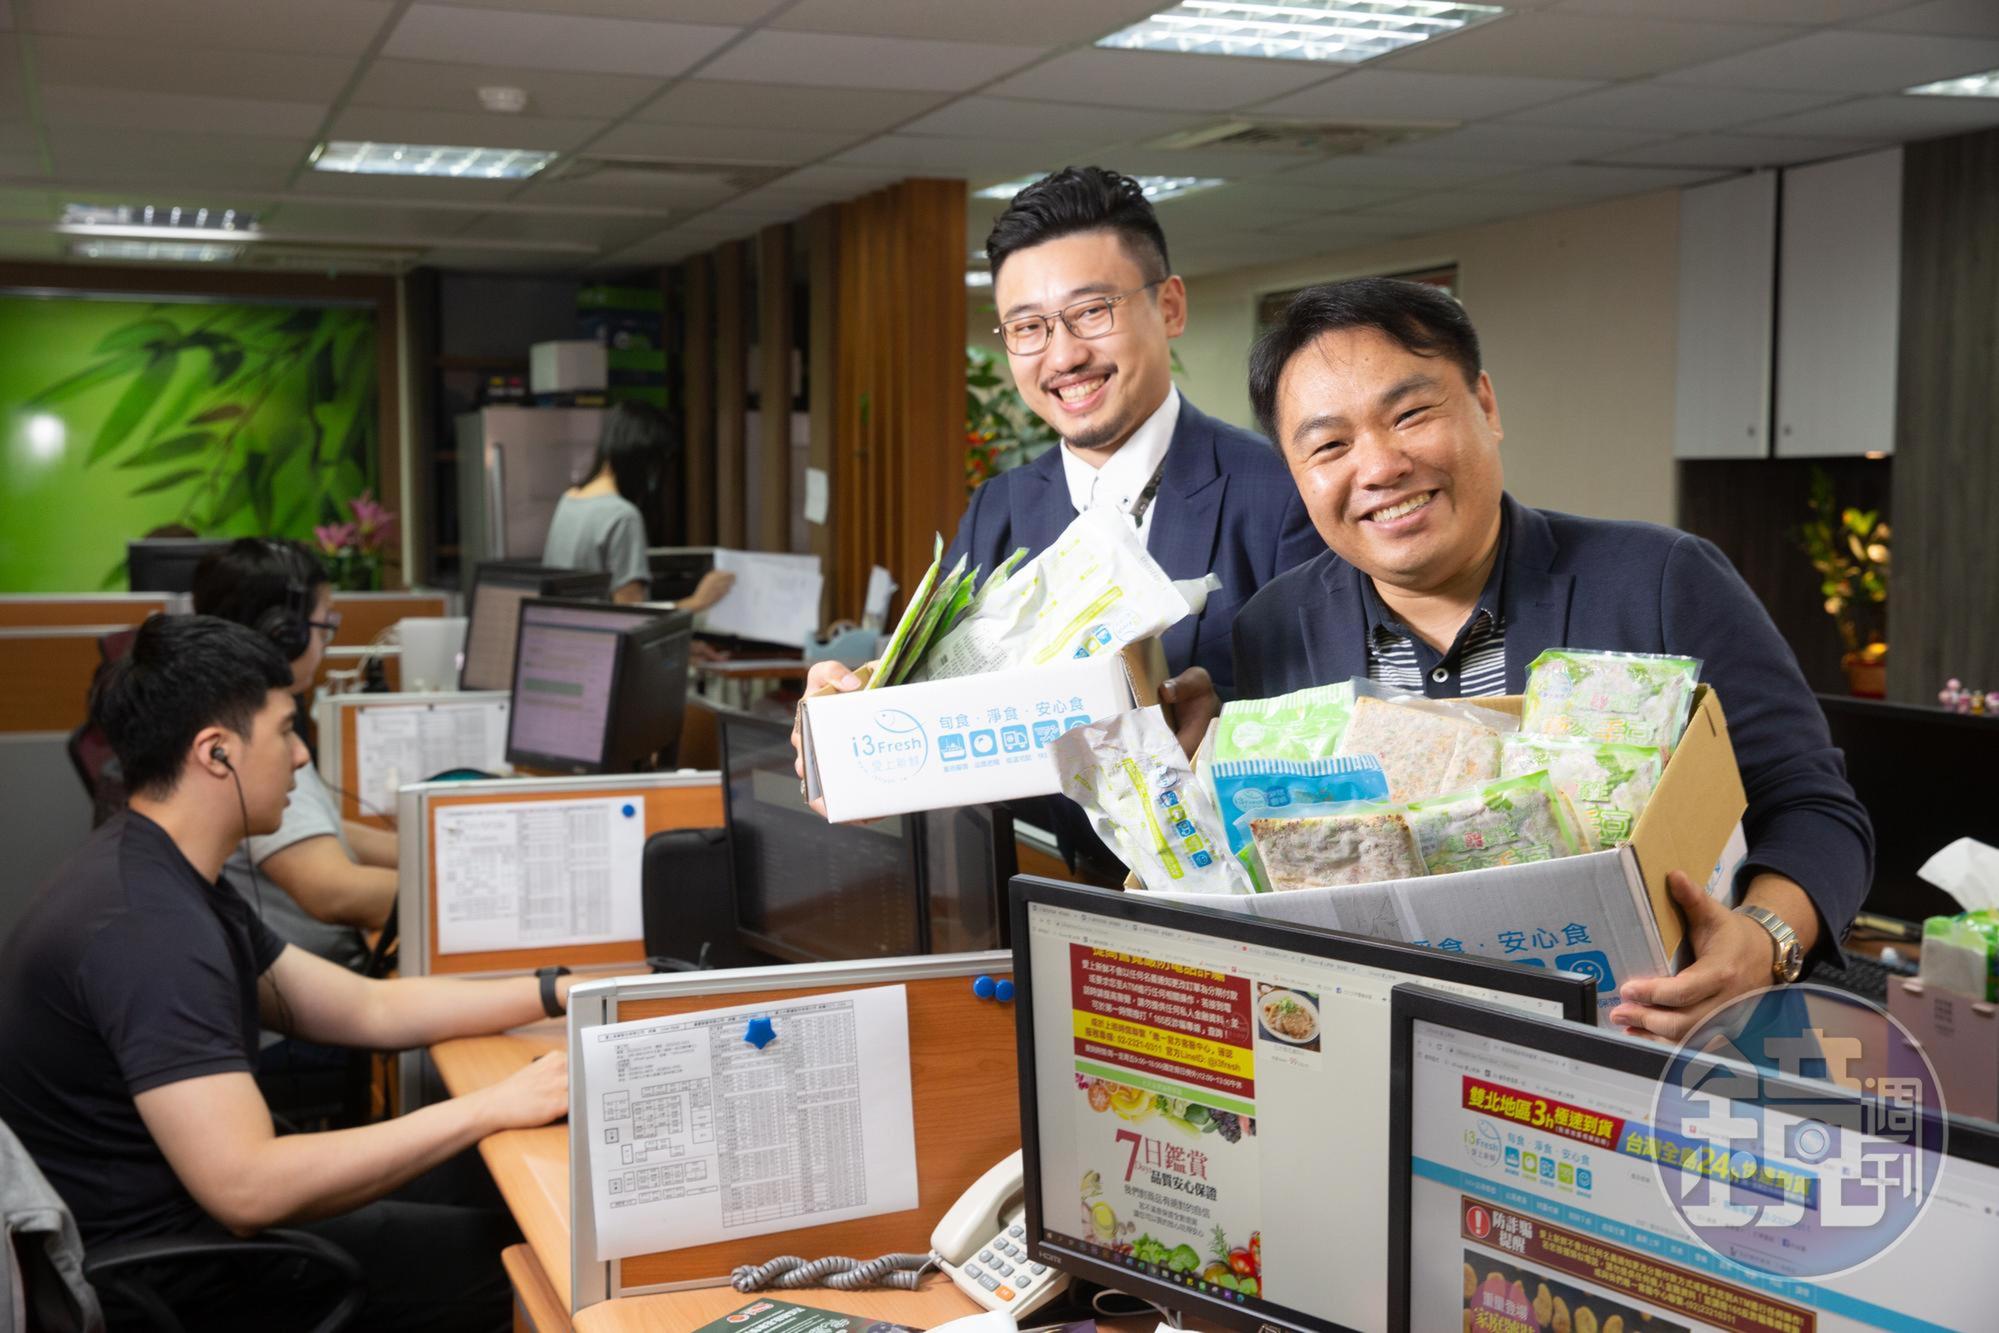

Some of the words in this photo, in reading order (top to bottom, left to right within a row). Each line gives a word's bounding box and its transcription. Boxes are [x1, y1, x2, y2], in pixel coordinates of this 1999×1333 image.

[1150, 1169, 1218, 1202] 品質安心保證
[1491, 1210, 1533, 1240] 防詐騙
[1498, 1231, 1527, 1254] 提醒
